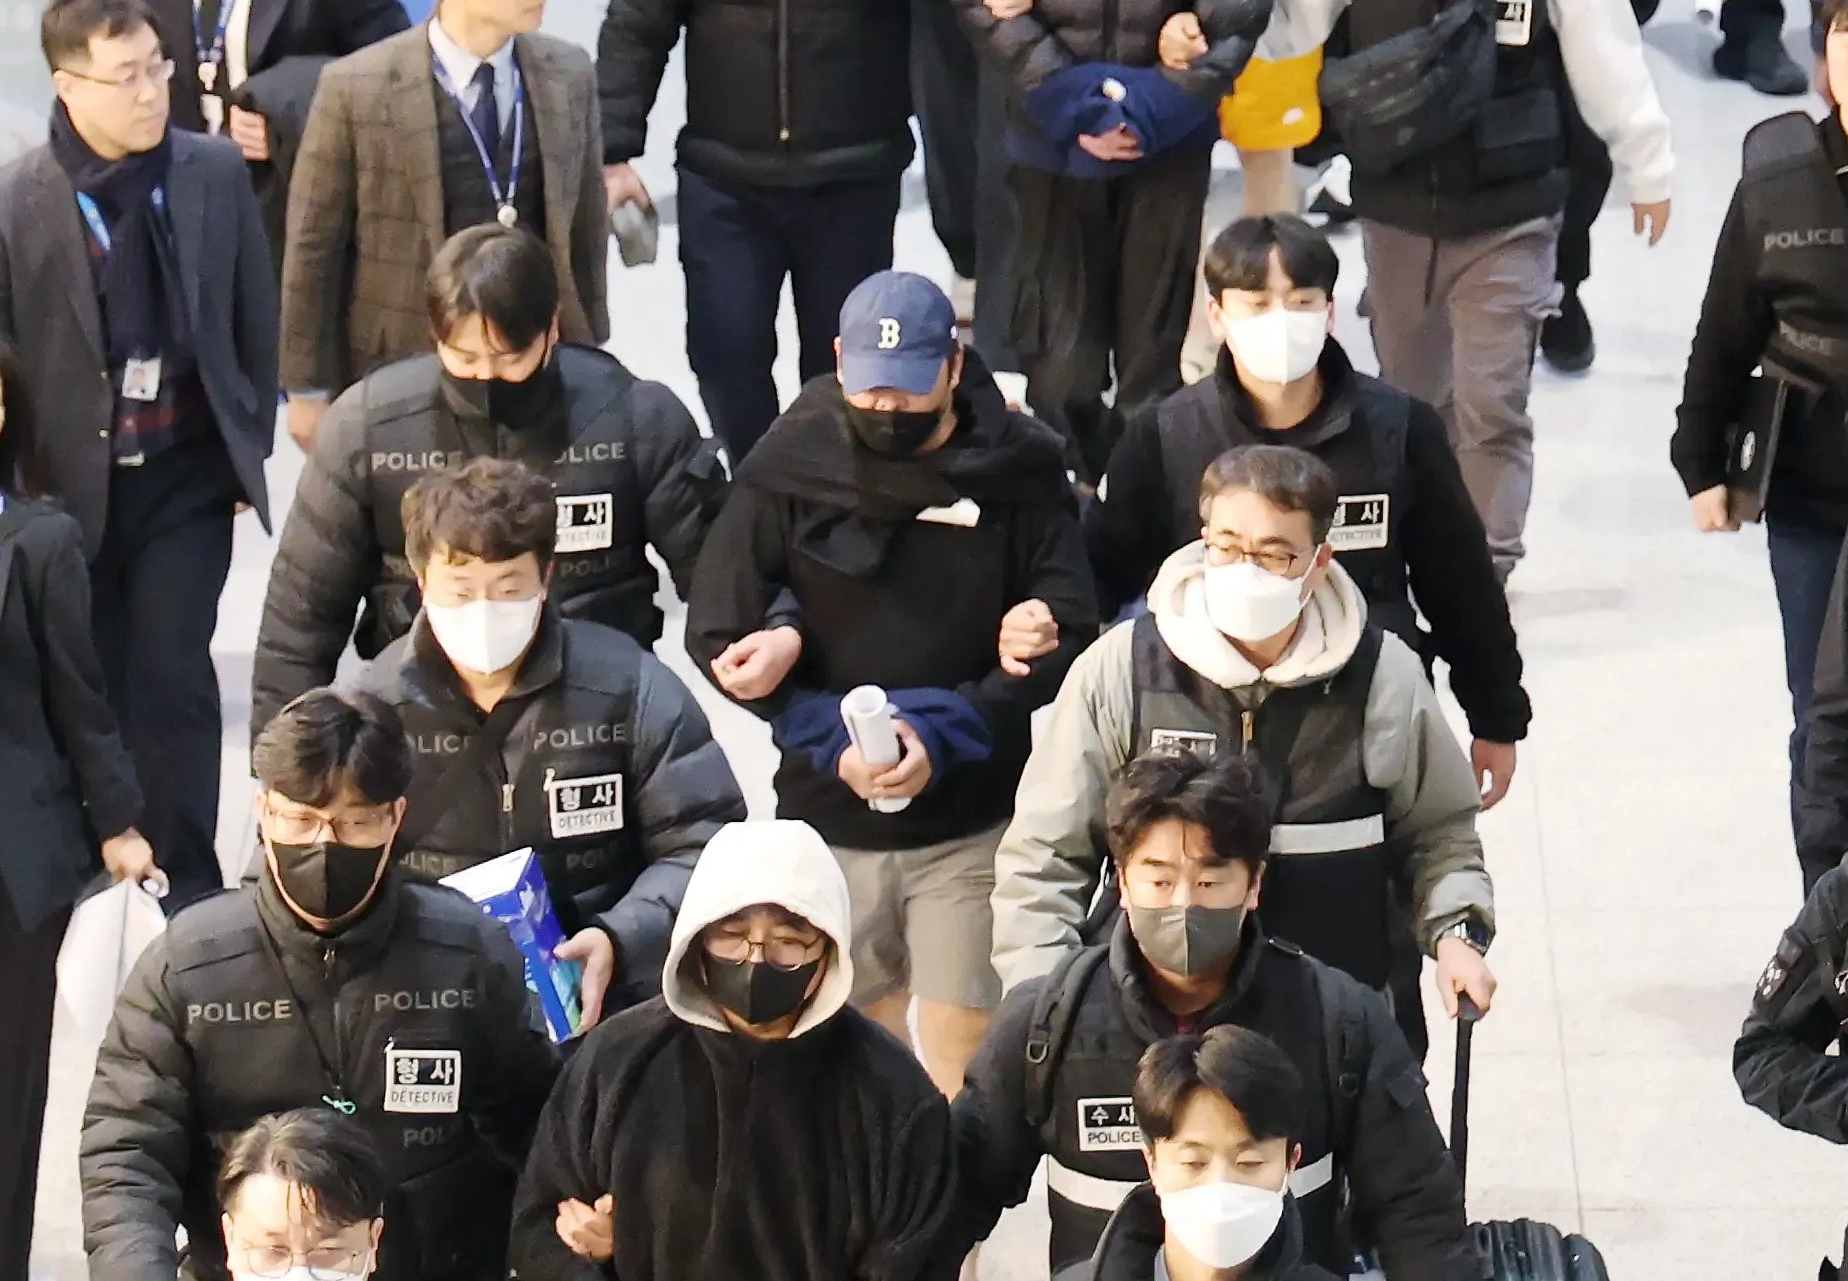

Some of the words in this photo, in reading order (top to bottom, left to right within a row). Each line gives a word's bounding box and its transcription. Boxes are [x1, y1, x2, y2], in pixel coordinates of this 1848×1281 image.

[1764, 228, 1844, 250] POLICE
[877, 317, 901, 349] B
[554, 442, 626, 463] LICE
[534, 723, 628, 750] POLICE
[187, 999, 293, 1024] POLICE
[374, 987, 477, 1013] POLICE
[396, 1058, 454, 1085] 형사
[391, 1089, 454, 1105] DETECTIVE
[1088, 1130, 1141, 1143] POLICE
